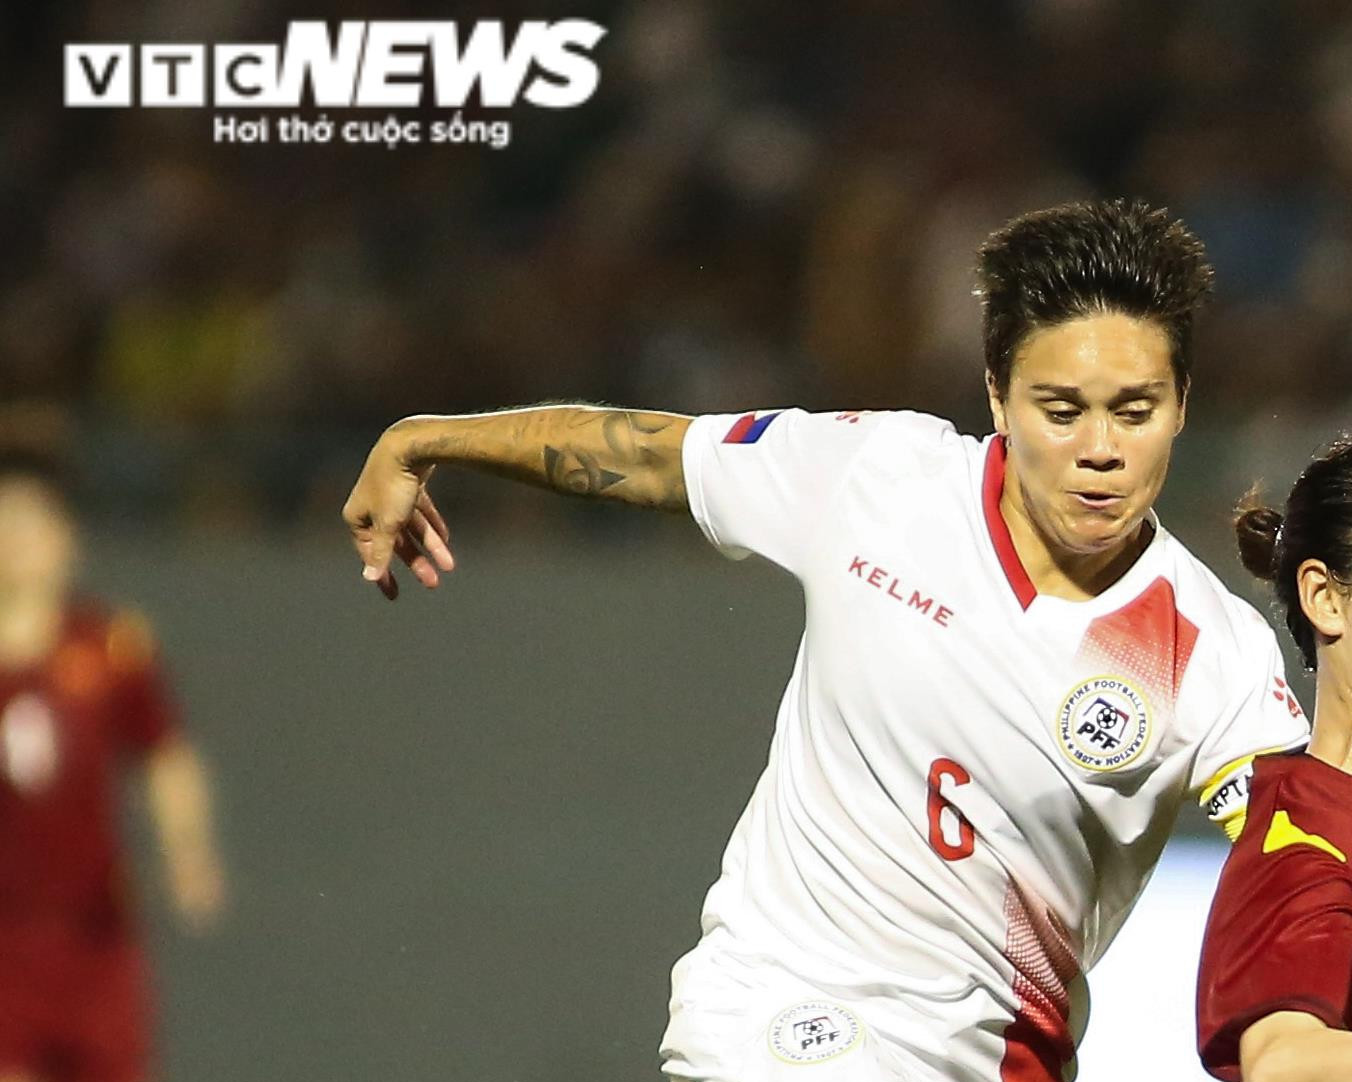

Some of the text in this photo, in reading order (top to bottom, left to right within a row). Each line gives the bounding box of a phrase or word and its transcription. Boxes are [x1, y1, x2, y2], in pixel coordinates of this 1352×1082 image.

[848, 556, 954, 628] KELME
[1077, 721, 1121, 750] PFF
[927, 757, 975, 862] 6
[801, 1030, 841, 1050] PFF
